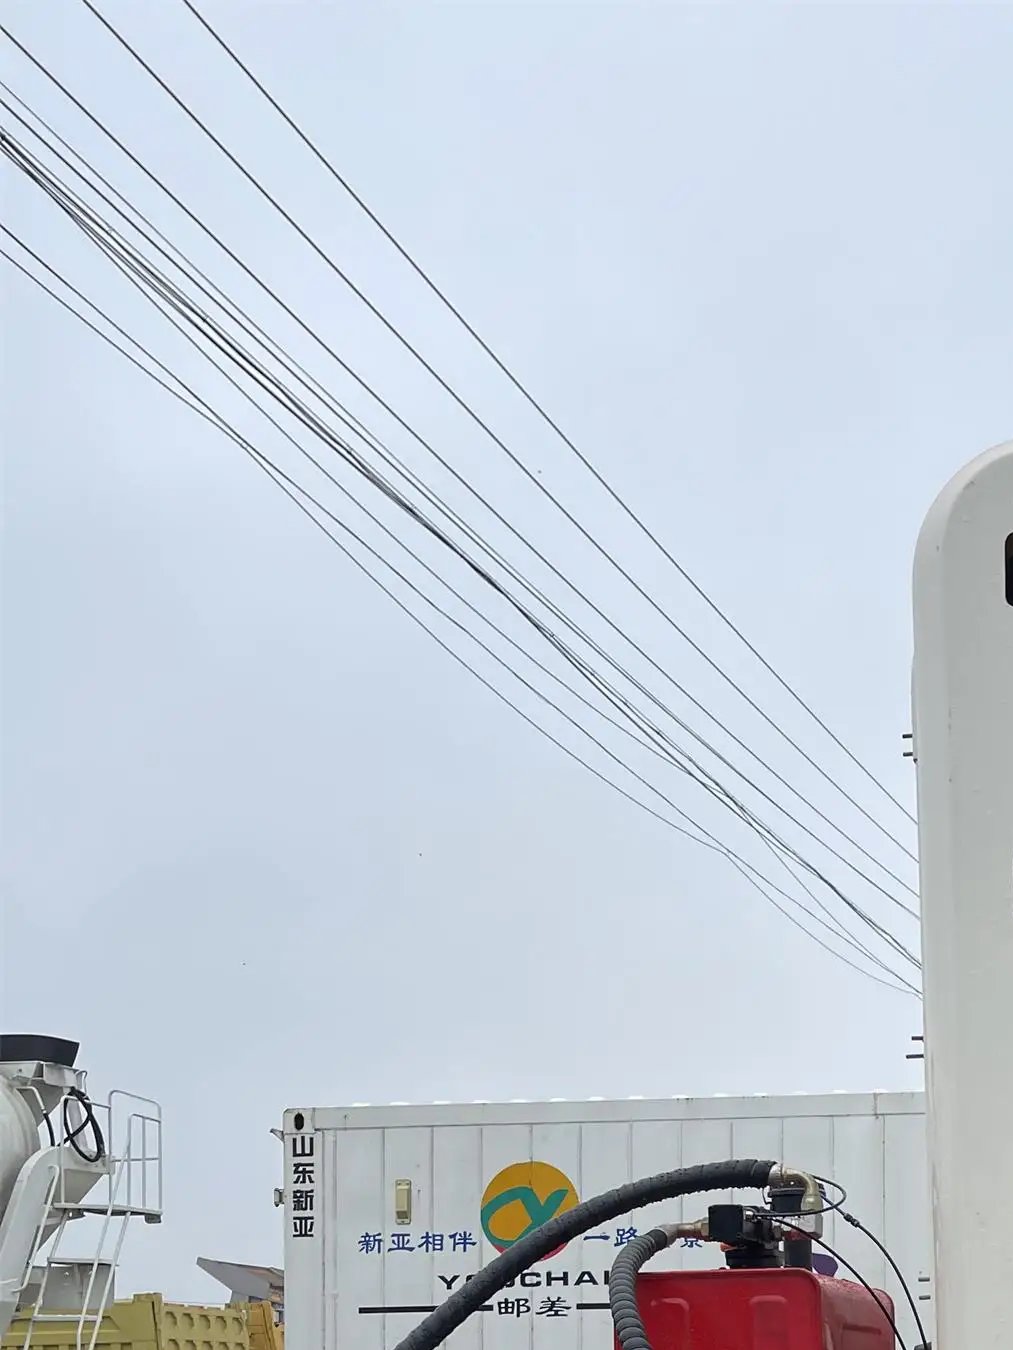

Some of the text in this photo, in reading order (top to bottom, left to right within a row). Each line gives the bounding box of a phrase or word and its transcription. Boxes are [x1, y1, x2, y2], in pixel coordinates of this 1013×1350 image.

[292, 1135, 315, 1238] 山东新亚
[358, 1231, 478, 1254] 新亚相伴
[438, 1270, 610, 1290] YCHAI
[497, 1296, 572, 1317] 邮差
